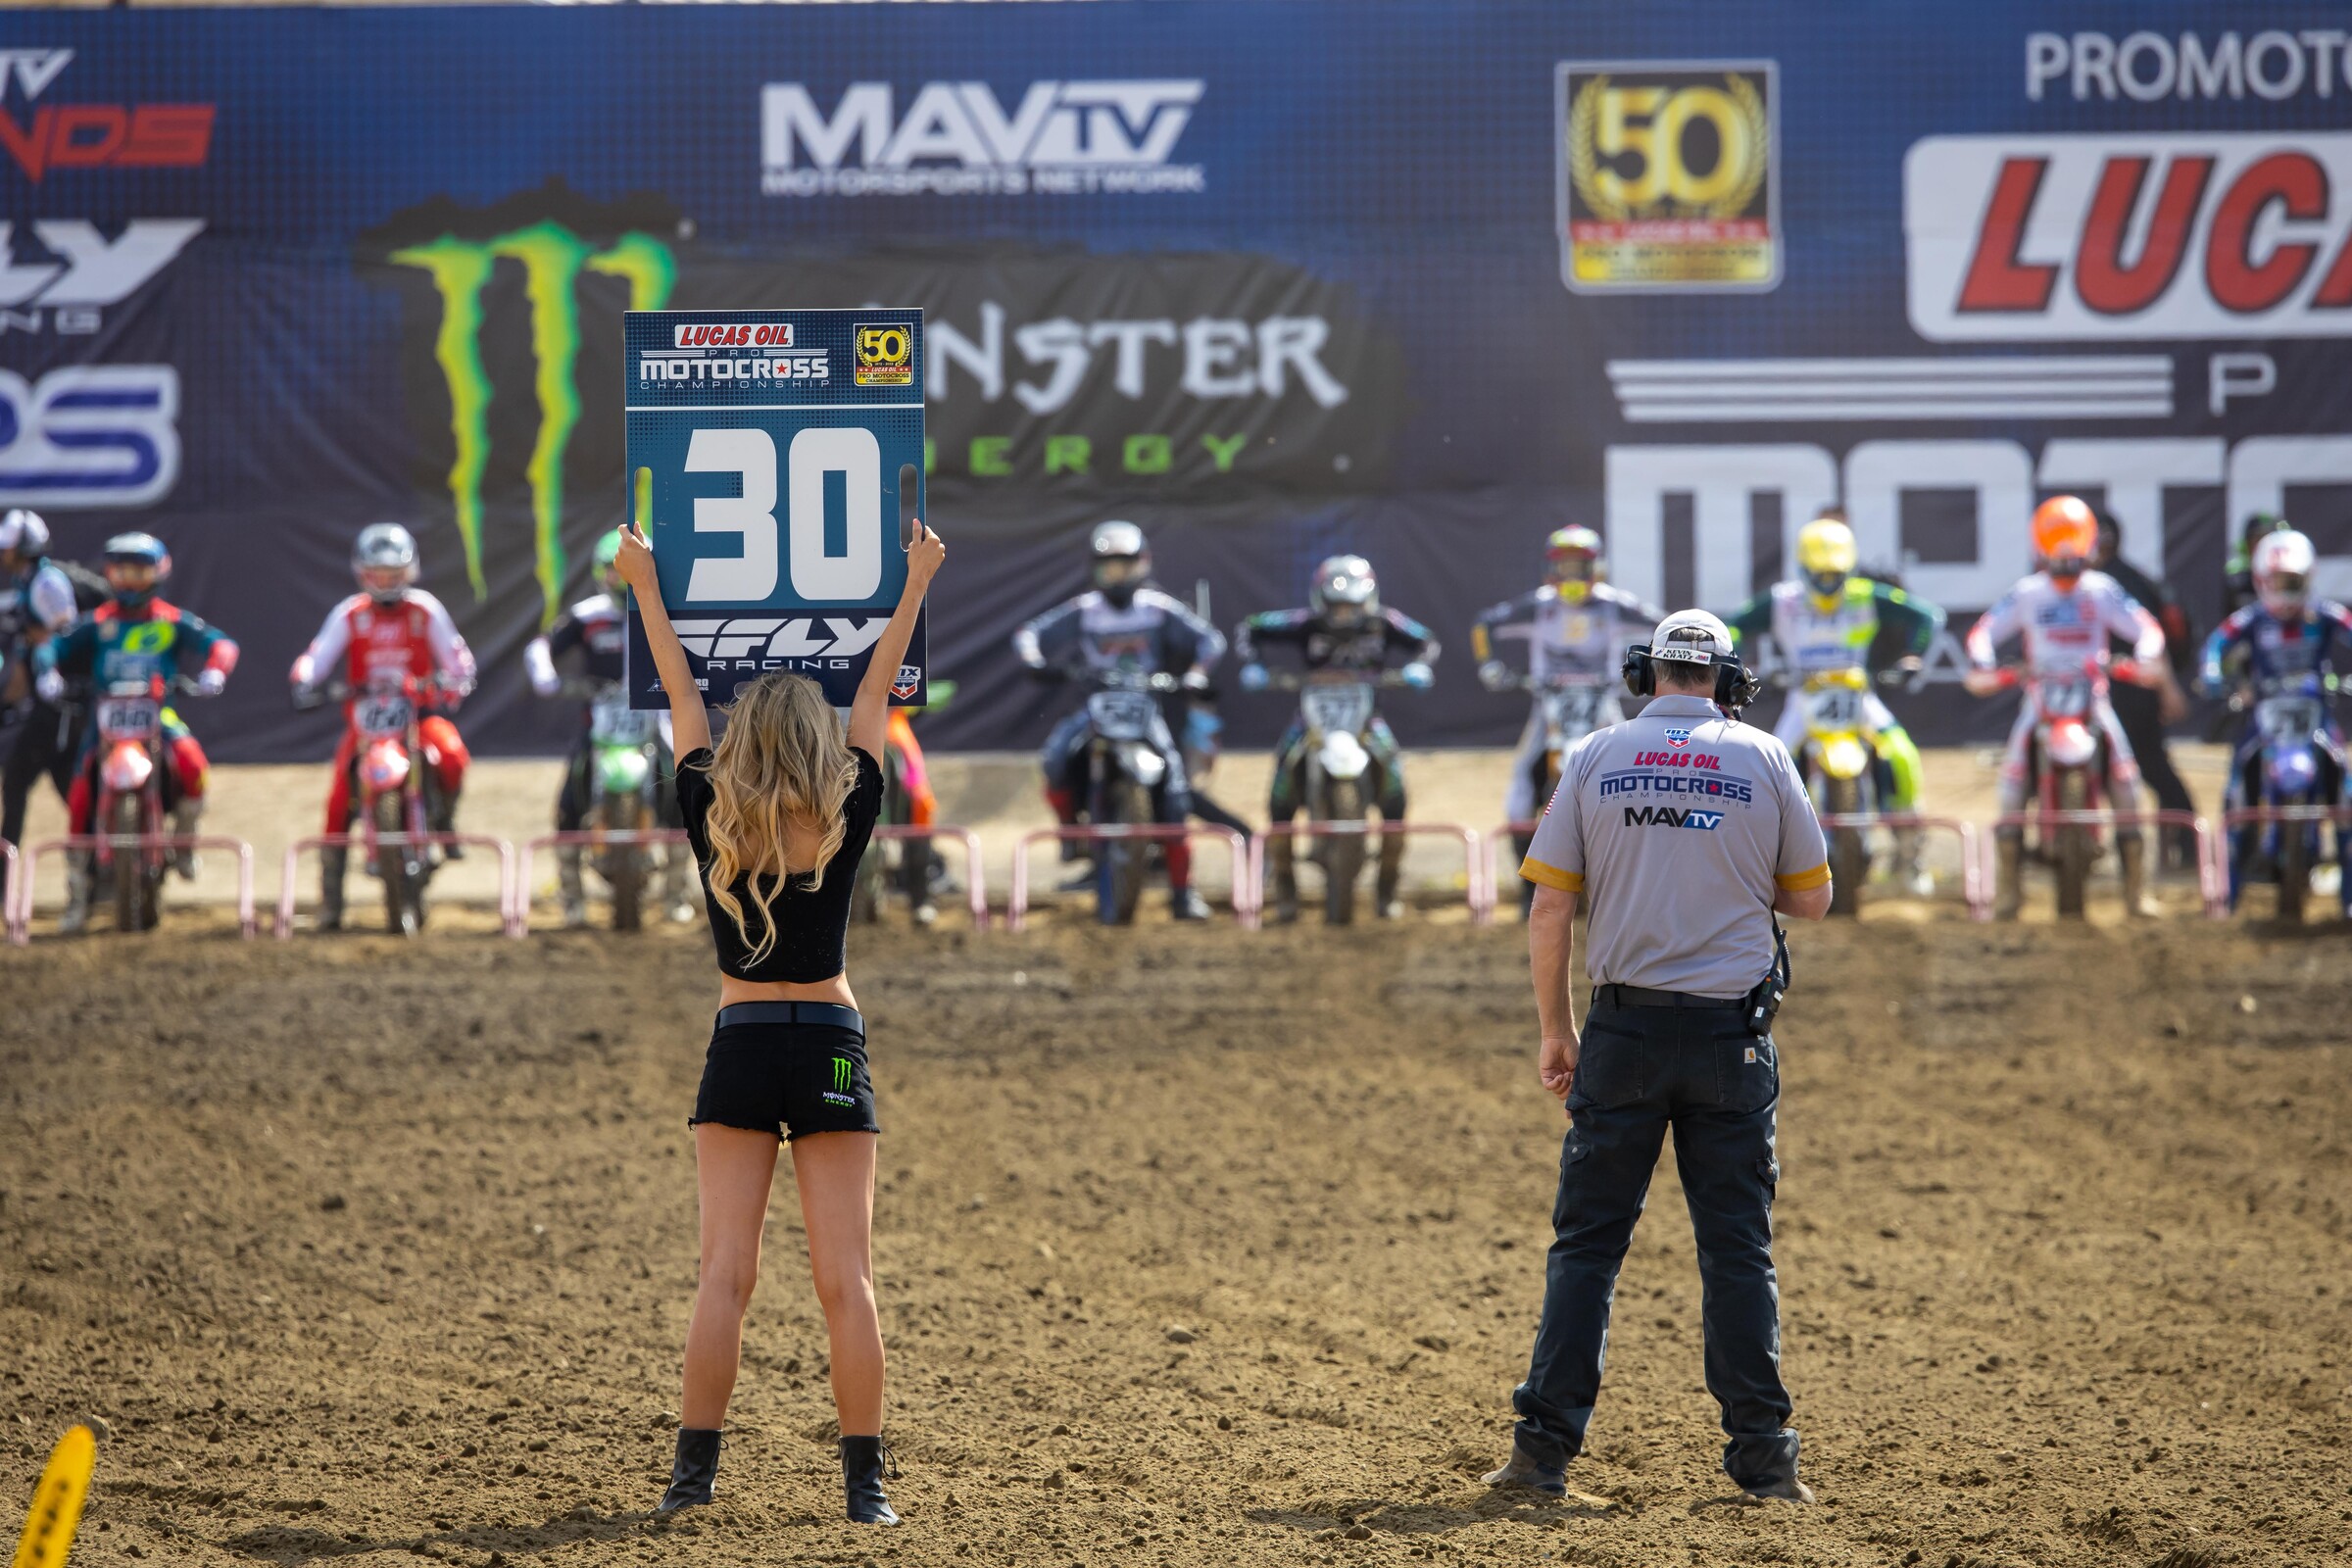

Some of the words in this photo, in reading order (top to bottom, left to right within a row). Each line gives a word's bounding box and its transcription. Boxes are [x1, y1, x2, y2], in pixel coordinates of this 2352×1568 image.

[2027, 30, 2352, 102] PROMOT
[760, 79, 1204, 168] MAVTV
[1593, 87, 1750, 204] 50
[679, 325, 751, 346] LUCAS
[754, 325, 791, 346] OIL
[863, 330, 906, 362] 50
[709, 349, 760, 358] PRO
[925, 301, 1350, 416] NSTER
[640, 358, 829, 380] MOTOCROSS
[640, 380, 830, 390] CHAMPIONSHIP
[926, 432, 1248, 478] ERGY
[683, 427, 882, 602] 30
[669, 617, 892, 658] FLY
[707, 659, 850, 671] RACING
[1634, 751, 1691, 767] LUCAS
[1692, 754, 1721, 771] OIL
[1655, 768, 1697, 777] PRO
[1599, 775, 1752, 804] MOTOCROSS
[1599, 792, 1751, 809] CHAMPIONSHIP
[1624, 806, 1725, 831] MAVTV
[822, 1091, 856, 1104] MONSTER
[825, 1099, 853, 1107] ENERGY
